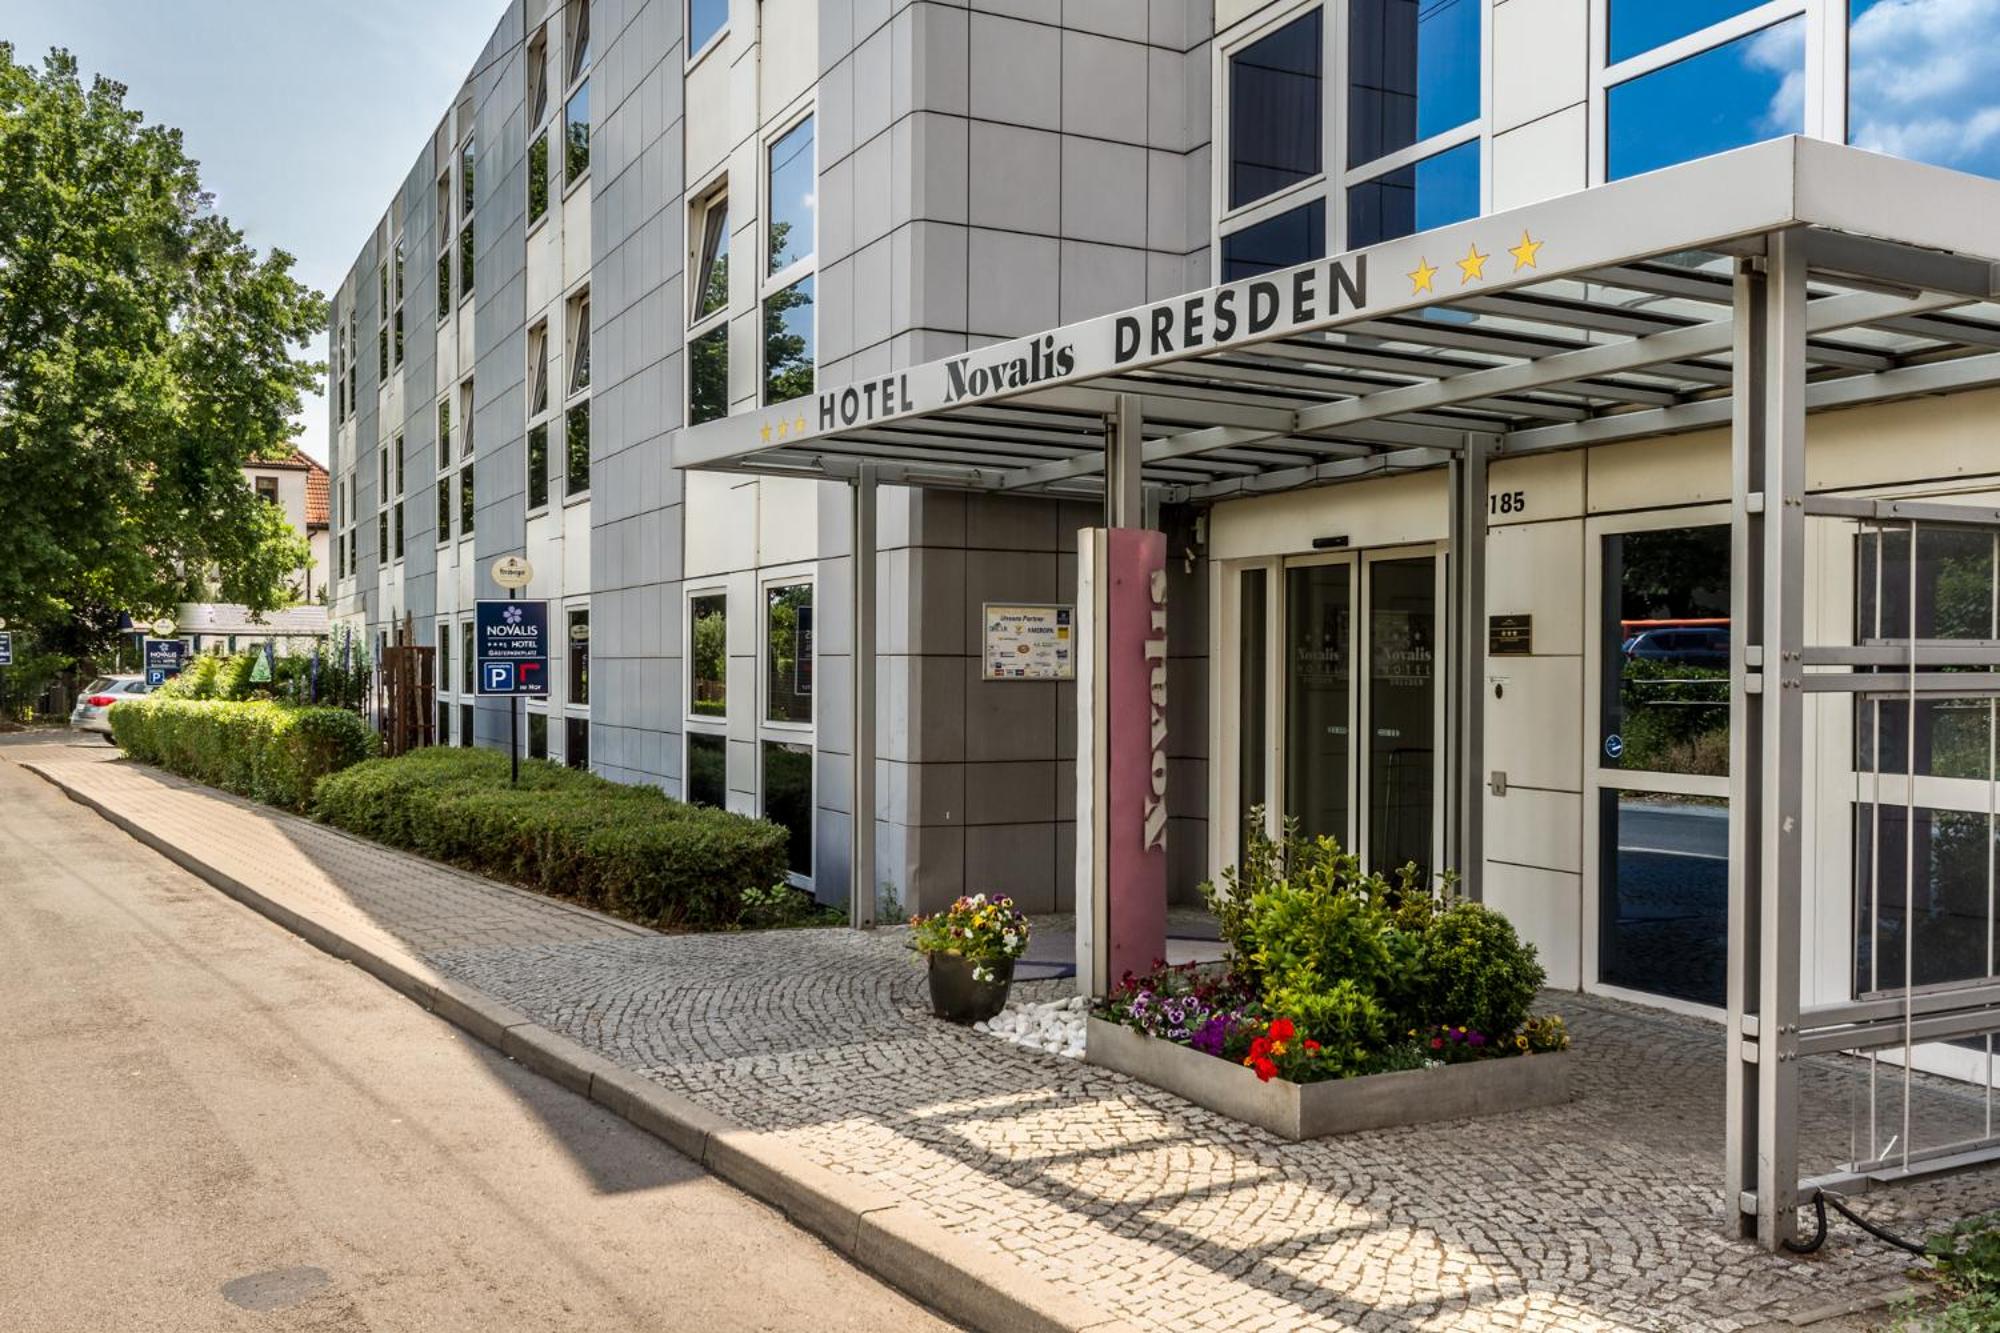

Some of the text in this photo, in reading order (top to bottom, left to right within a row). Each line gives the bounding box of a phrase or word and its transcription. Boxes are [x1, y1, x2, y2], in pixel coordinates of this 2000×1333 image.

[819, 254, 1367, 431] HOTEL Novalis DRESDEN
[1490, 491, 1525, 514] 185
[486, 623, 539, 636] NOVALIS
[511, 640, 538, 649] HOTEL
[1383, 646, 1432, 661] Novalis
[152, 672, 161, 682] P
[491, 668, 507, 688] P
